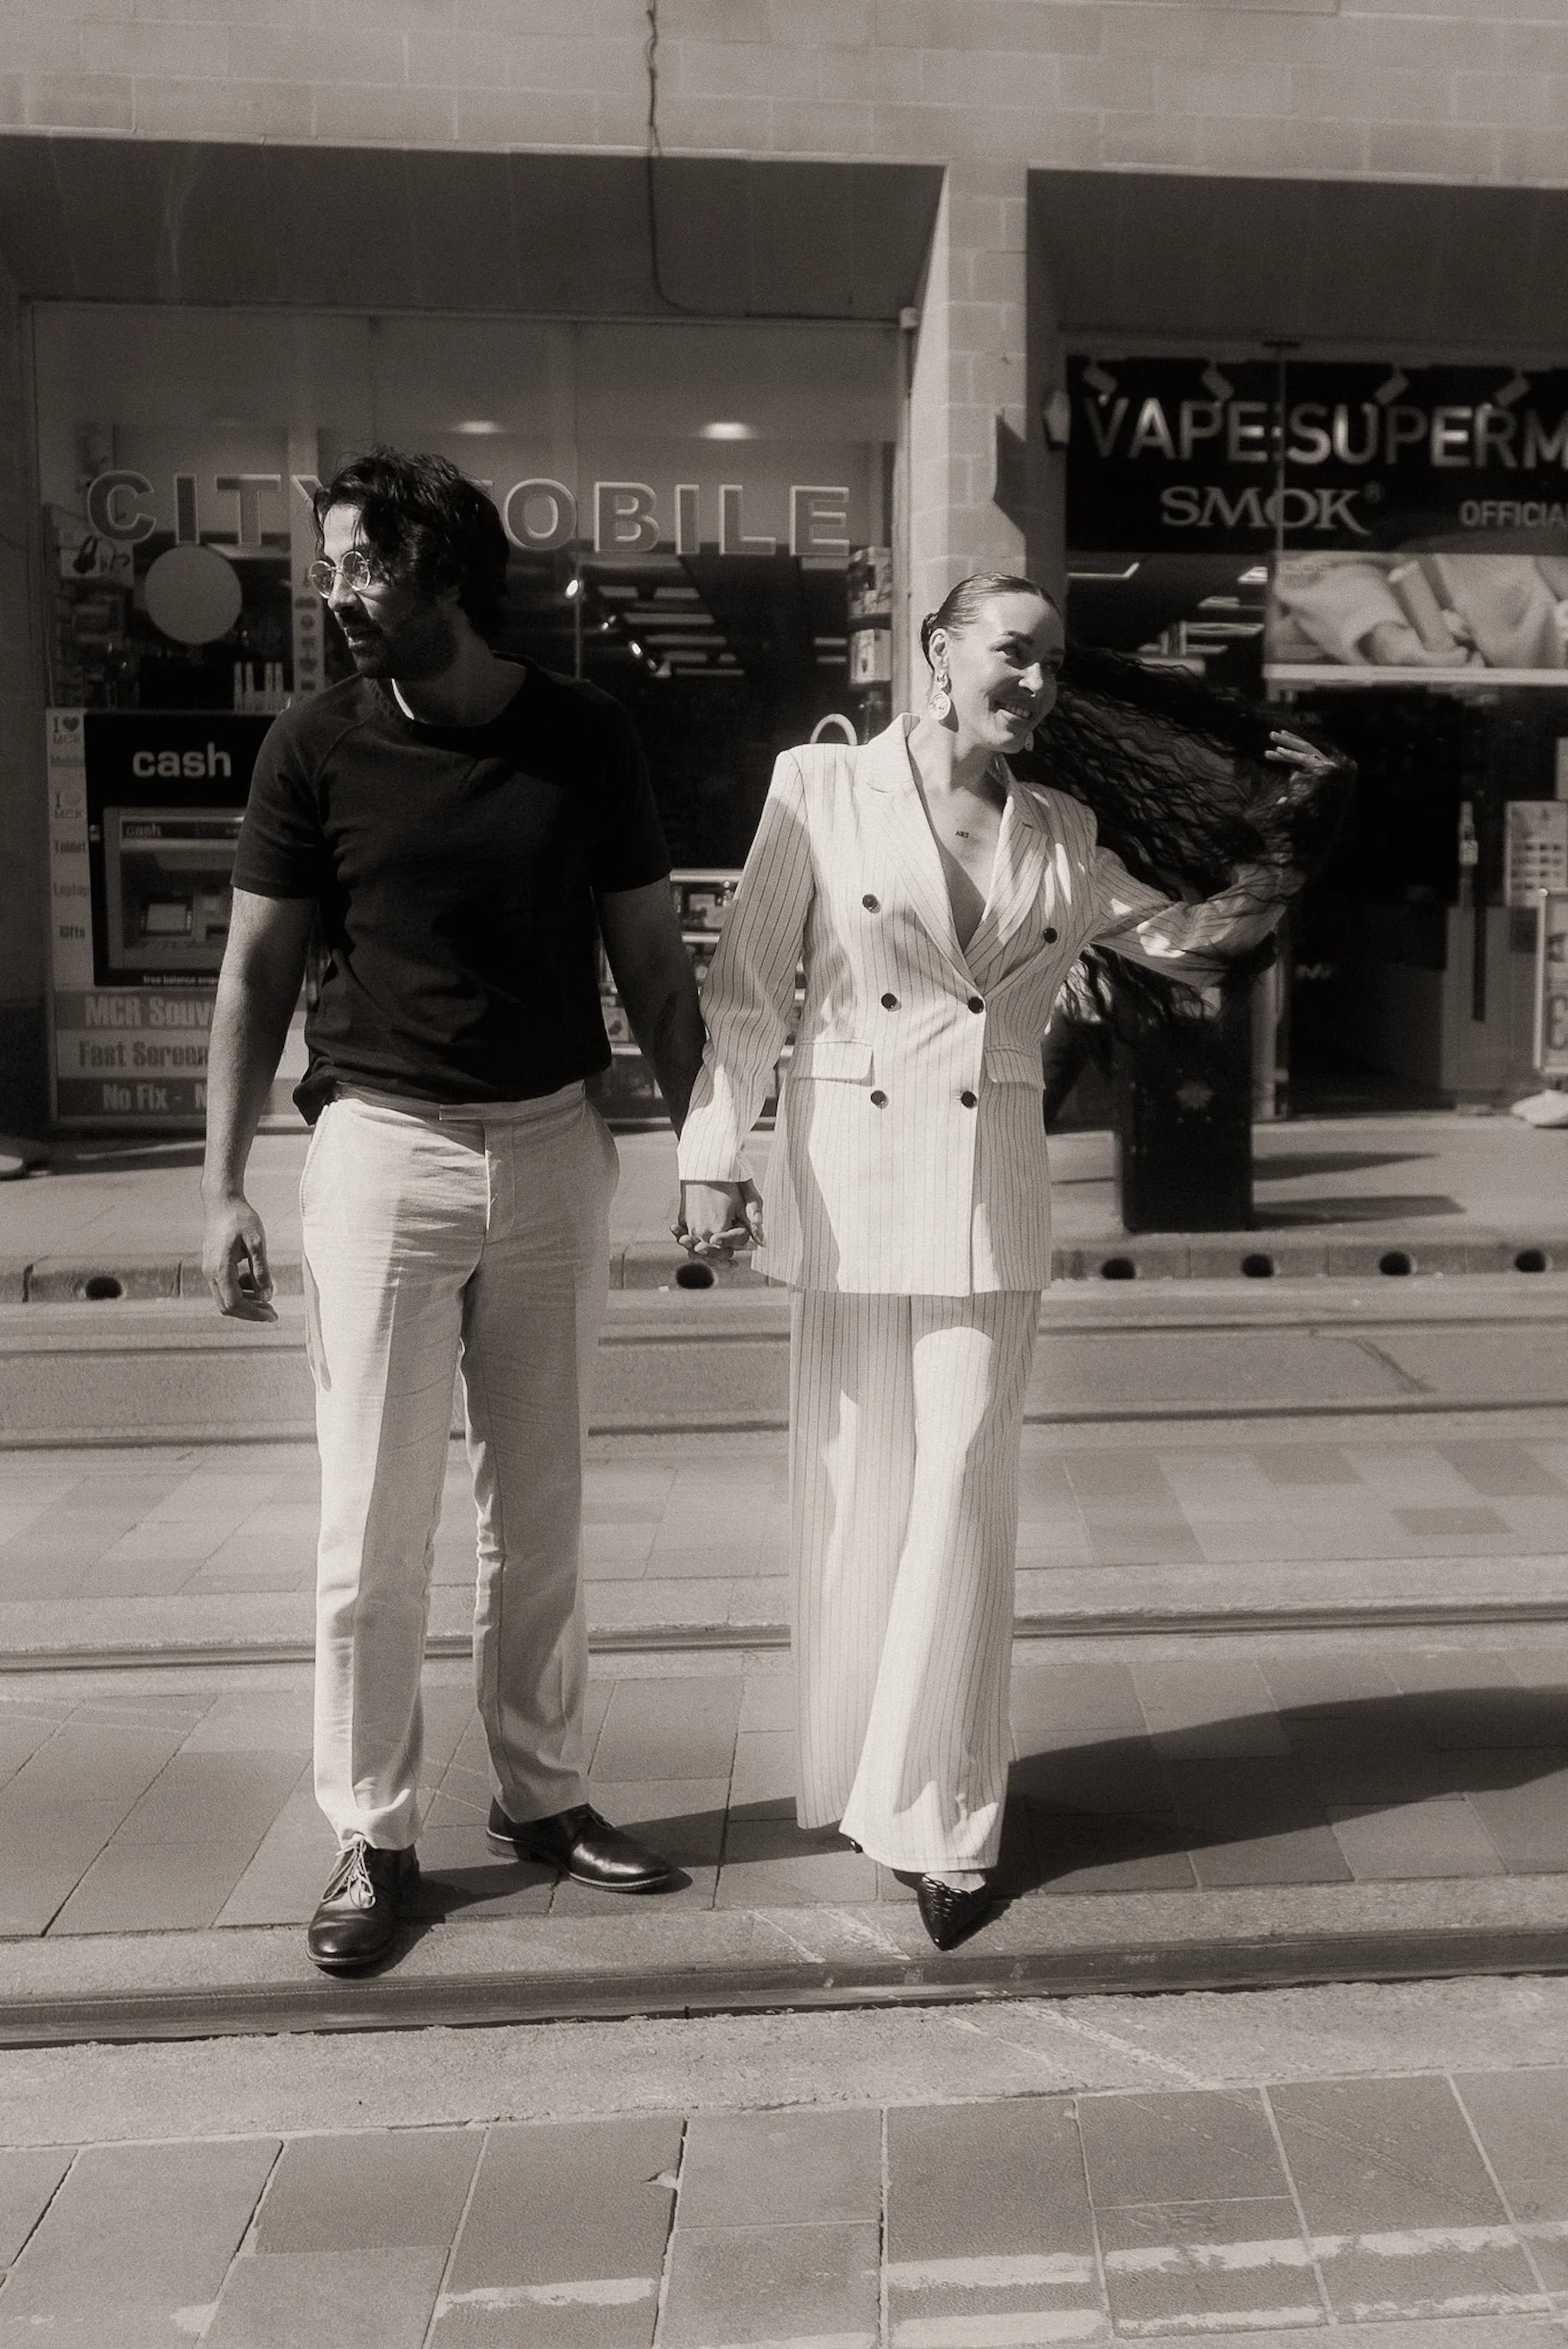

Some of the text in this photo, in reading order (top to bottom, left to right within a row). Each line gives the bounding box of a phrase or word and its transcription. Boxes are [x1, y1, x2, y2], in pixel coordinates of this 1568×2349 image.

[1083, 397, 1568, 470] VAPE SUPERM
[466, 478, 851, 557] OBILE
[1459, 499, 1568, 528] OFFICIA
[132, 742, 232, 778] cash
[85, 995, 214, 1027] MCR Souv
[79, 1041, 127, 1067] Fast
[103, 1083, 132, 1109] No
[136, 1083, 168, 1109] Fix
